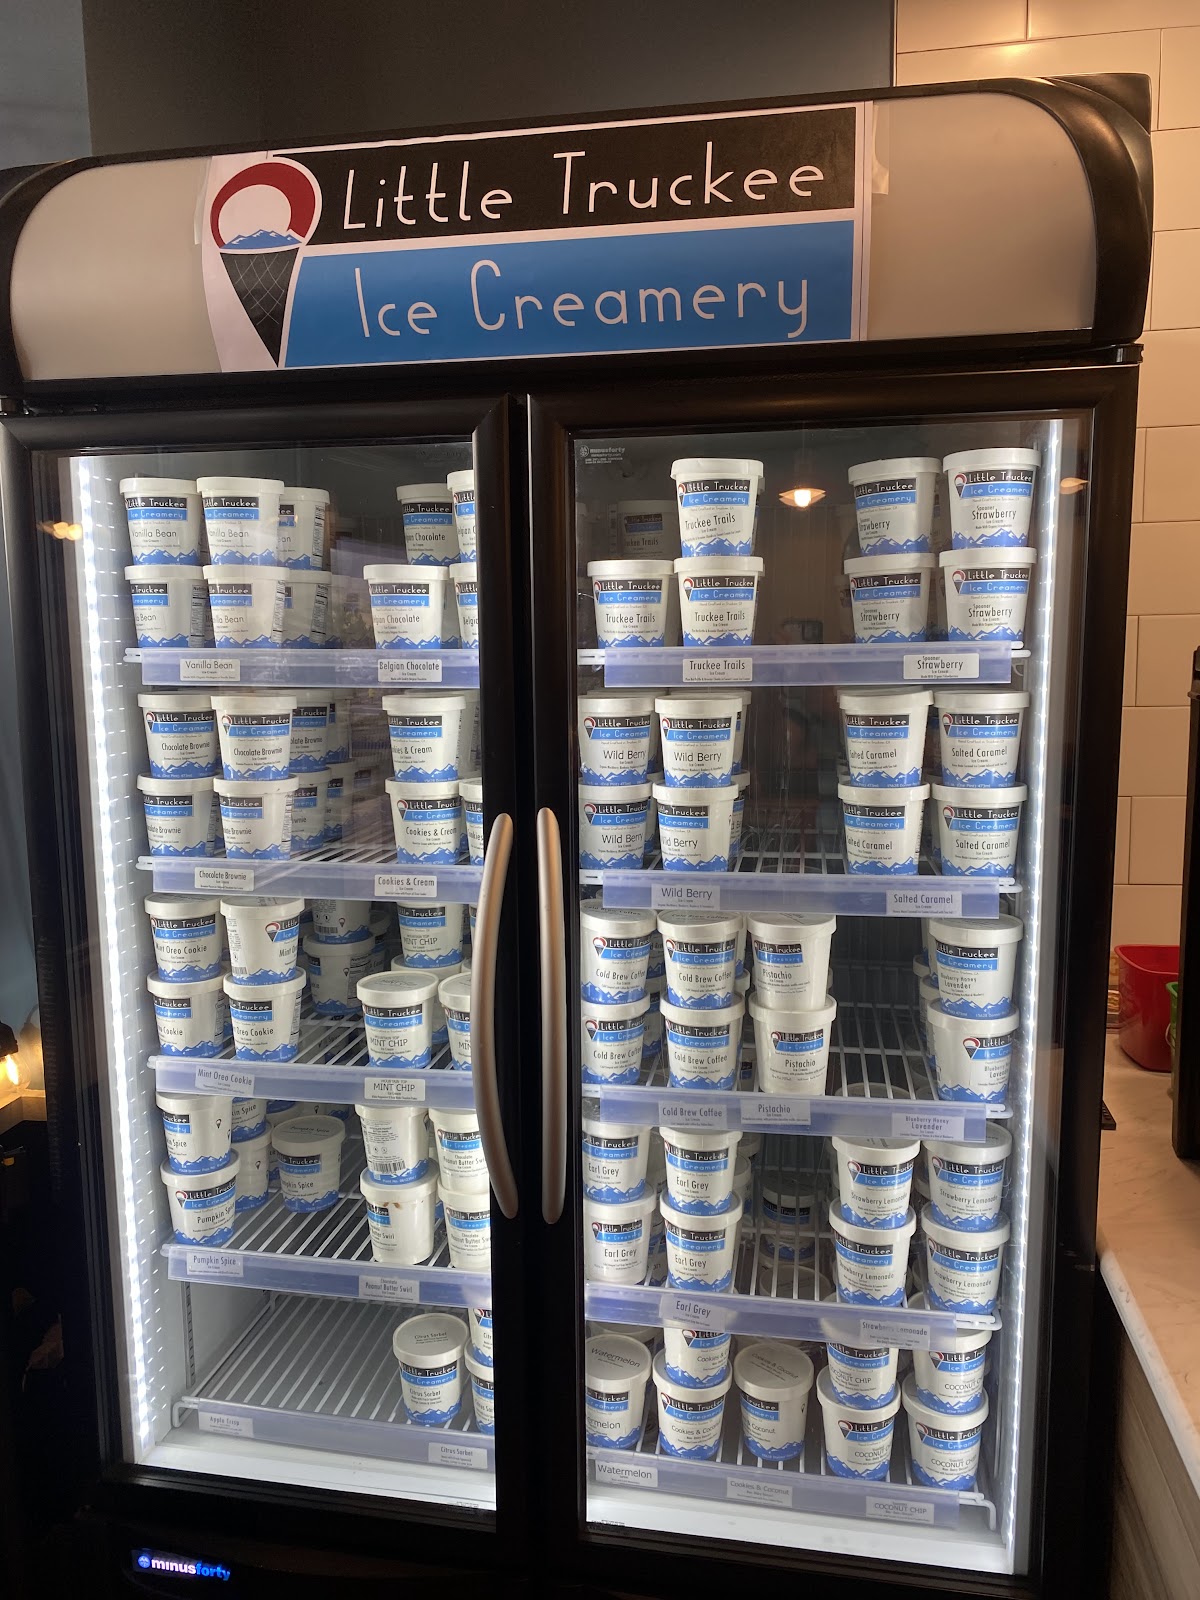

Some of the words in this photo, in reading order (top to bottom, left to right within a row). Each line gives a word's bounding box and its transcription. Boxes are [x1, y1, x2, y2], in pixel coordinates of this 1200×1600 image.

[343, 160, 512, 230] Little
[553, 141, 823, 214] Truckee
[355, 267, 437, 338] Ice
[471, 259, 808, 339] Creamery
[970, 474, 996, 482] Little
[1000, 472, 1032, 481] Truckee
[988, 485, 1029, 495] Creamery
[972, 510, 1016, 520] Strawberry
[685, 519, 711, 530] Truckee
[714, 513, 735, 524] Trails
[415, 533, 445, 541] Chocolate
[628, 582, 660, 590] Truckee
[695, 612, 723, 622] Truckee
[727, 612, 745, 620] Trails
[861, 613, 900, 621] Strawberry
[969, 608, 1012, 617] Strawberry
[387, 615, 419, 623] Chocolate
[606, 614, 633, 623] Truckee
[636, 613, 655, 622] Trails
[186, 661, 211, 669] Vanilla
[214, 661, 233, 669] Bean
[379, 662, 404, 672] Belgian
[407, 661, 439, 670] Chocolate
[690, 661, 720, 670] Truckee
[724, 660, 745, 670] Trails
[917, 660, 963, 670] Strawberry
[671, 720, 693, 728] Little
[698, 720, 729, 728] Truckee
[985, 716, 1017, 724] Truckee
[687, 732, 727, 740] Creamery
[972, 728, 1015, 736] Creamery
[161, 742, 188, 750] Chocolate
[190, 742, 210, 750] Brownie
[234, 748, 261, 756] Chocolate
[603, 751, 624, 759] Wild
[628, 750, 646, 760] Berry
[674, 751, 694, 761] Wild
[698, 752, 721, 762] Berry
[952, 748, 973, 757] Salted
[977, 747, 1008, 757] Caramel
[602, 835, 623, 843] Wild
[626, 833, 643, 843] Berry
[674, 838, 698, 848] Berry
[862, 841, 892, 850] Caramel
[956, 839, 978, 848] Salted
[982, 840, 1010, 849] Caramel
[199, 871, 224, 879] Chocolate
[225, 872, 246, 880] Brownie
[378, 877, 403, 886] Cookies
[406, 877, 411, 885] &
[413, 877, 435, 886] Cream
[661, 887, 682, 897] Wild
[686, 888, 712, 899] Berry
[894, 895, 917, 903] Salted
[921, 895, 953, 904] Caramel
[279, 948, 290, 957] Mint
[677, 944, 700, 952] Little
[704, 944, 734, 953] Truckee
[679, 973, 693, 982] Cold
[695, 974, 712, 983] Brew
[715, 971, 731, 981] Coffee
[763, 969, 792, 980] Pistachio
[945, 981, 971, 989] Lavender
[164, 1027, 183, 1035] Cookie
[237, 1027, 249, 1035] Oreo
[251, 1028, 274, 1036] Cookie
[674, 1052, 686, 1061] Cold
[688, 1055, 704, 1064] Brew
[707, 1054, 727, 1063] Coffee
[785, 1060, 816, 1068] Pistachio
[198, 1068, 211, 1077] Mint
[214, 1072, 228, 1081] Oreo
[231, 1075, 252, 1085] Cookie
[374, 1083, 394, 1091] MINT
[396, 1083, 415, 1091] CHIP
[242, 1105, 256, 1115] Spice
[663, 1108, 677, 1116] Cold
[680, 1108, 697, 1116] Brew
[700, 1108, 722, 1117] Coffee
[758, 1104, 790, 1112] Pistachio
[911, 1122, 942, 1130] Lavender
[173, 1139, 187, 1147] Spice
[588, 1163, 601, 1174] Earl
[603, 1166, 619, 1176] Grey
[945, 1163, 969, 1173] Little
[974, 1165, 1002, 1173] Truckee
[298, 1181, 313, 1189] Spice
[677, 1177, 690, 1186] Earl
[692, 1180, 709, 1190] Grey
[940, 1188, 970, 1203] Strawberry
[972, 1195, 997, 1203] Lemonade
[466, 1236, 482, 1244] Butter
[604, 1249, 620, 1258] Earl
[621, 1248, 637, 1257] Grey
[193, 1256, 219, 1265] Pumpkin
[220, 1257, 236, 1265] Spice
[675, 1255, 686, 1264] Earl
[688, 1258, 706, 1268] Grey
[933, 1268, 962, 1286] Strawberry
[963, 1279, 991, 1287] Lemonade
[365, 1283, 382, 1291] Peanut
[676, 1301, 692, 1311] Earl
[693, 1305, 711, 1317] Grey
[591, 1348, 640, 1368] Watermelon
[672, 1400, 694, 1411] Little
[697, 1399, 723, 1411] Truckee
[227, 1418, 239, 1426] Crisp
[752, 1423, 776, 1433] Coconut
[457, 1448, 473, 1456] Sorbet
[855, 1447, 885, 1458] COCONUT
[932, 1458, 964, 1468] COCONUT
[598, 1465, 652, 1478] Watermelon
[730, 1481, 755, 1490] Cookies
[762, 1485, 789, 1495] Coconut
[875, 1503, 907, 1512] COCONUT
[152, 1559, 230, 1581] minusforty
